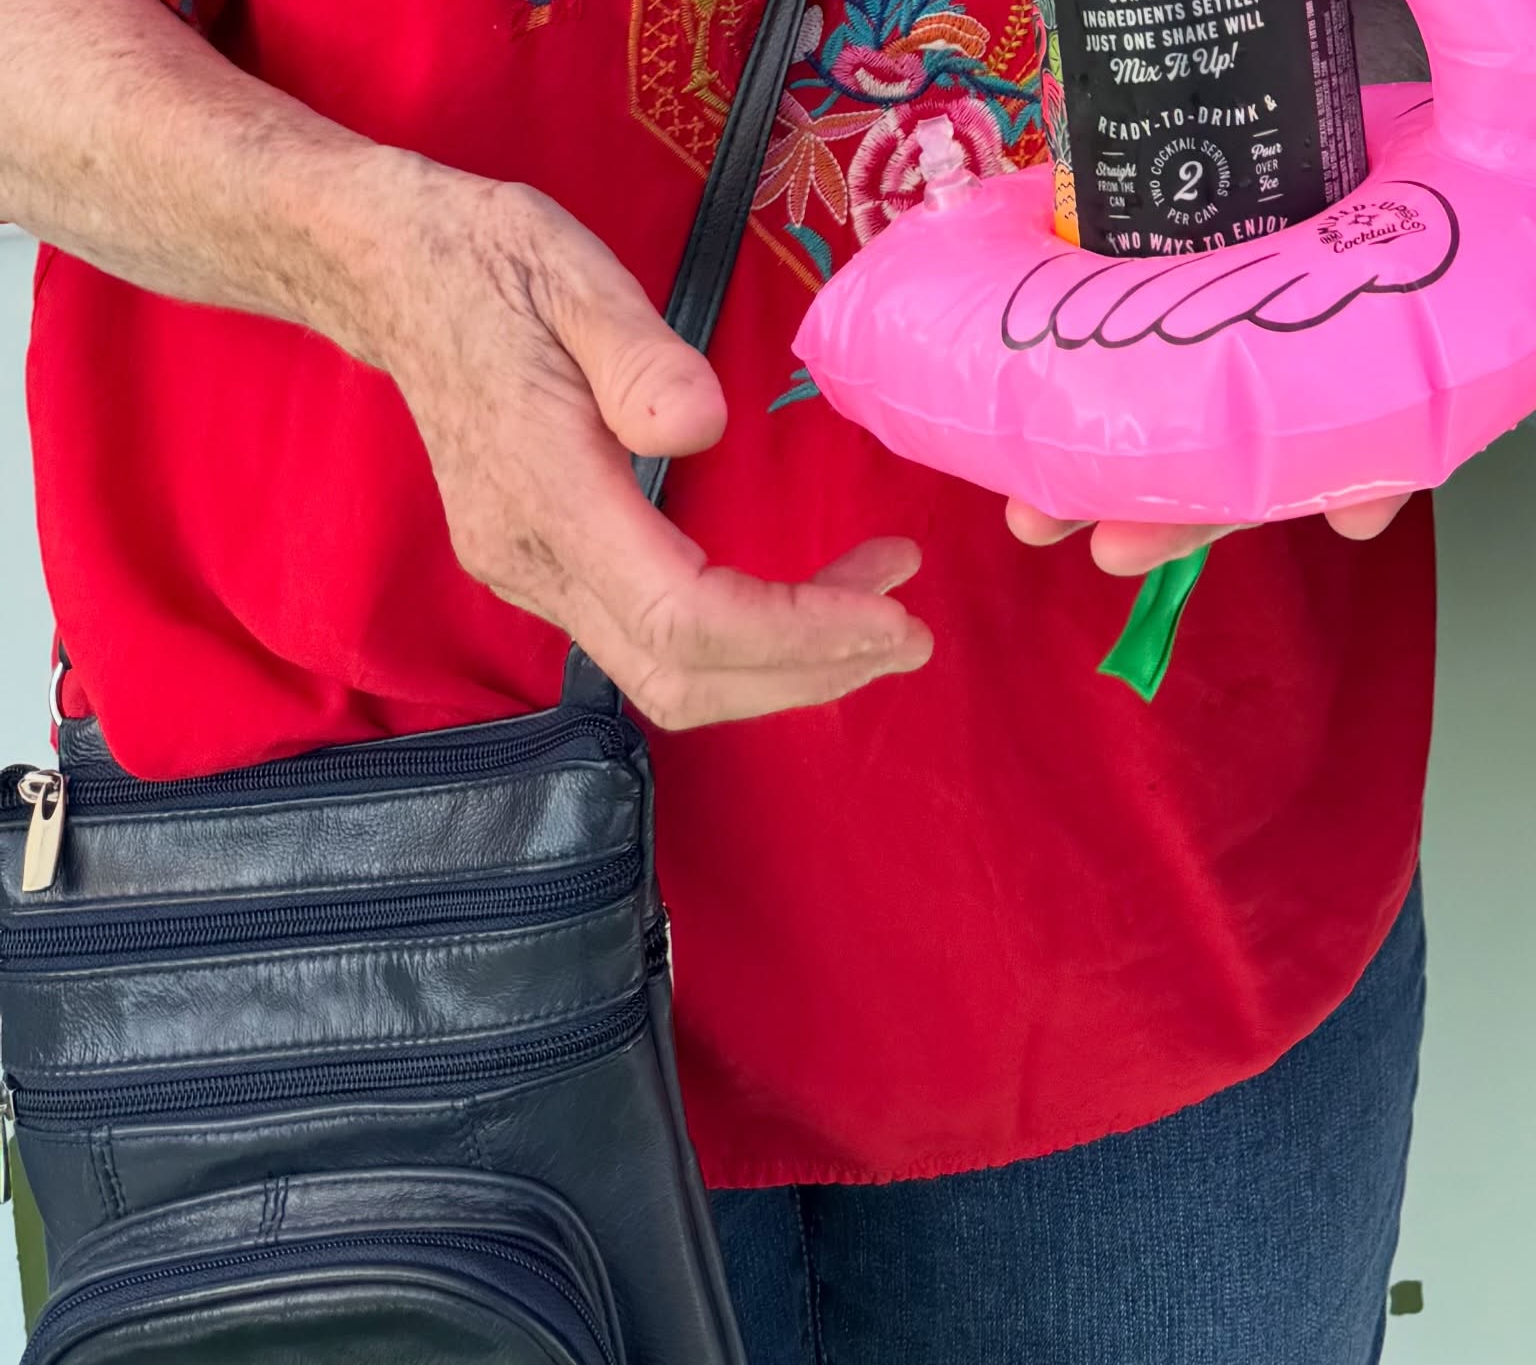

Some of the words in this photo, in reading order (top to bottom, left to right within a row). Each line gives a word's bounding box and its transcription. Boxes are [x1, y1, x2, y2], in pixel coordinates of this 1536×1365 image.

[1083, 3, 1186, 29] INGREDIENTS
[1086, 34, 1117, 52] JUST
[1123, 32, 1156, 51] ONE
[1162, 21, 1219, 47] SHAKE
[1224, 10, 1265, 35] WILL
[1110, 58, 1162, 85] Mix
[1164, 52, 1191, 81] It
[1193, 41, 1239, 79] Up!
[1098, 103, 1259, 141] READY-TO-DRINK
[1264, 94, 1278, 112] &
[1151, 137, 1196, 175] COCKTAIL
[1251, 142, 1283, 161] Pour
[1096, 161, 1137, 184] Straight
[1200, 140, 1231, 197] SERVINGS
[1255, 159, 1279, 175] OVER
[1098, 180, 1118, 193] FROM
[1120, 181, 1136, 194] THE
[1150, 181, 1166, 207] TWO
[1173, 160, 1203, 202] 2
[1259, 175, 1280, 193] Ice
[1109, 195, 1126, 208] CAN
[1167, 207, 1190, 226] PER
[1194, 202, 1219, 224] CAN
[1108, 231, 1141, 254] TWO
[1150, 231, 1195, 256] WAYS
[1203, 232, 1227, 252] TO
[1232, 215, 1289, 241] ENJOY
[1333, 224, 1398, 254] Cocktail
[1400, 218, 1422, 231] Co
